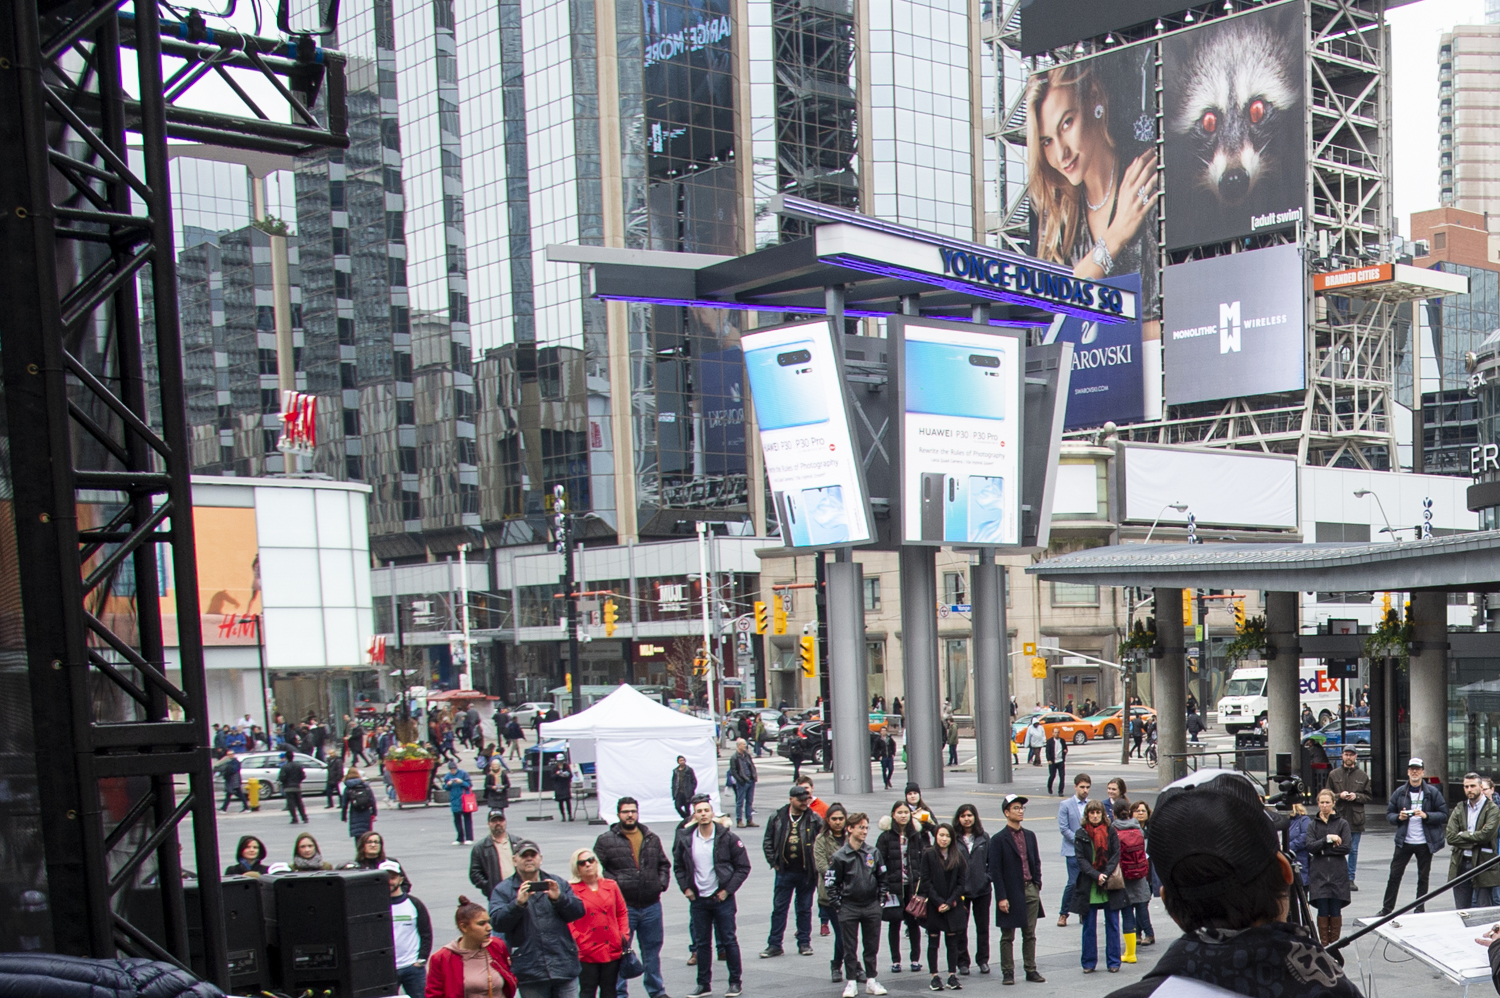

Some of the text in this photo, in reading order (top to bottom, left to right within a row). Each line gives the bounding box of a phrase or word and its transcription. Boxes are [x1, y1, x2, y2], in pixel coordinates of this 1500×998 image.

[938, 248, 1124, 313] YONGE-DUNDAS SQ
[1325, 267, 1380, 286] BRANDED CITIES
[1172, 314, 1287, 340] MONOLITHIC WIRELESS
[1071, 344, 1132, 371] AROVSKI
[1472, 371, 1487, 388] EX
[919, 428, 953, 438] HUAWEI
[956, 430, 969, 439] P30
[973, 432, 986, 440] P30
[218, 613, 257, 639] H&M
[1299, 670, 1340, 694] edEx
